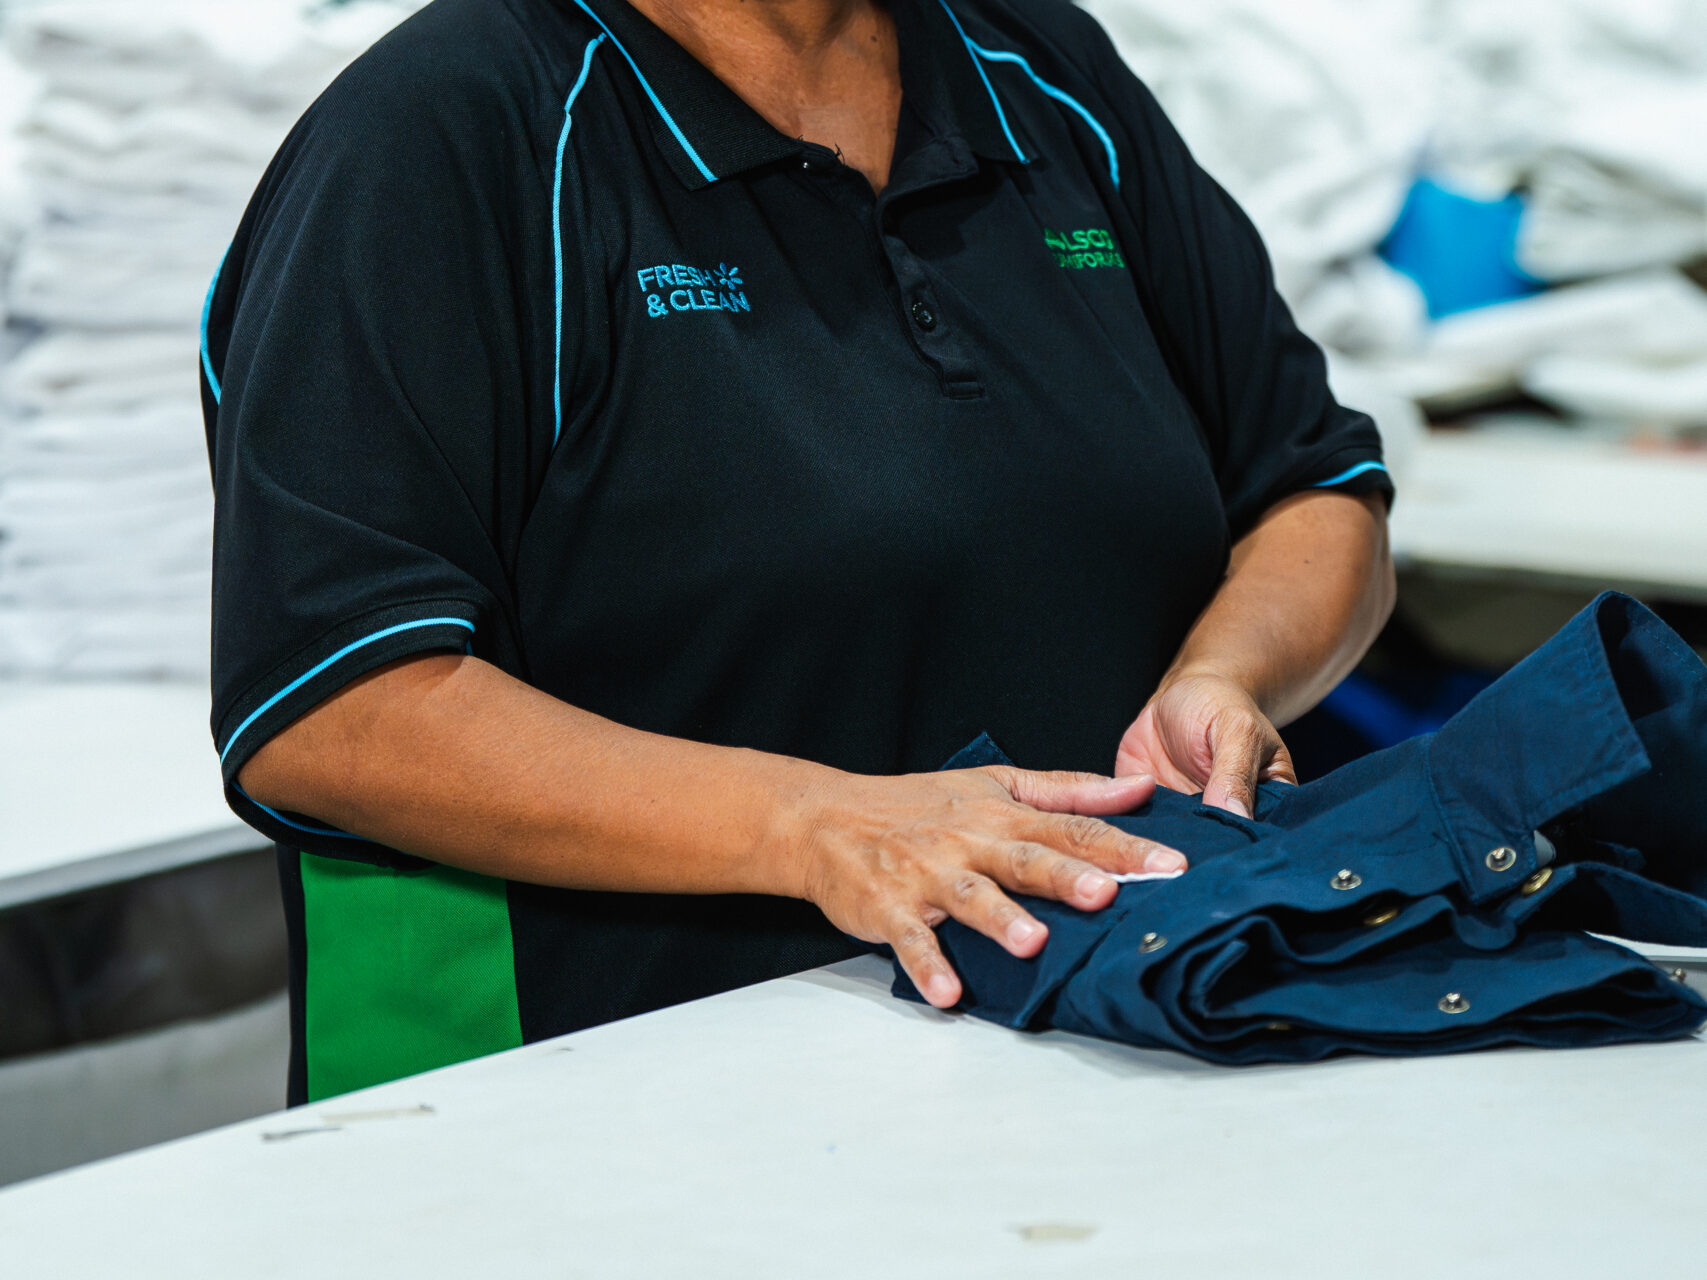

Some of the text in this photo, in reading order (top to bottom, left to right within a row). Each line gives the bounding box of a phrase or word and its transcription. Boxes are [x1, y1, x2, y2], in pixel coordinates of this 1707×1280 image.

[636, 263, 717, 292] FRESH
[646, 288, 751, 318] & CLEAN
